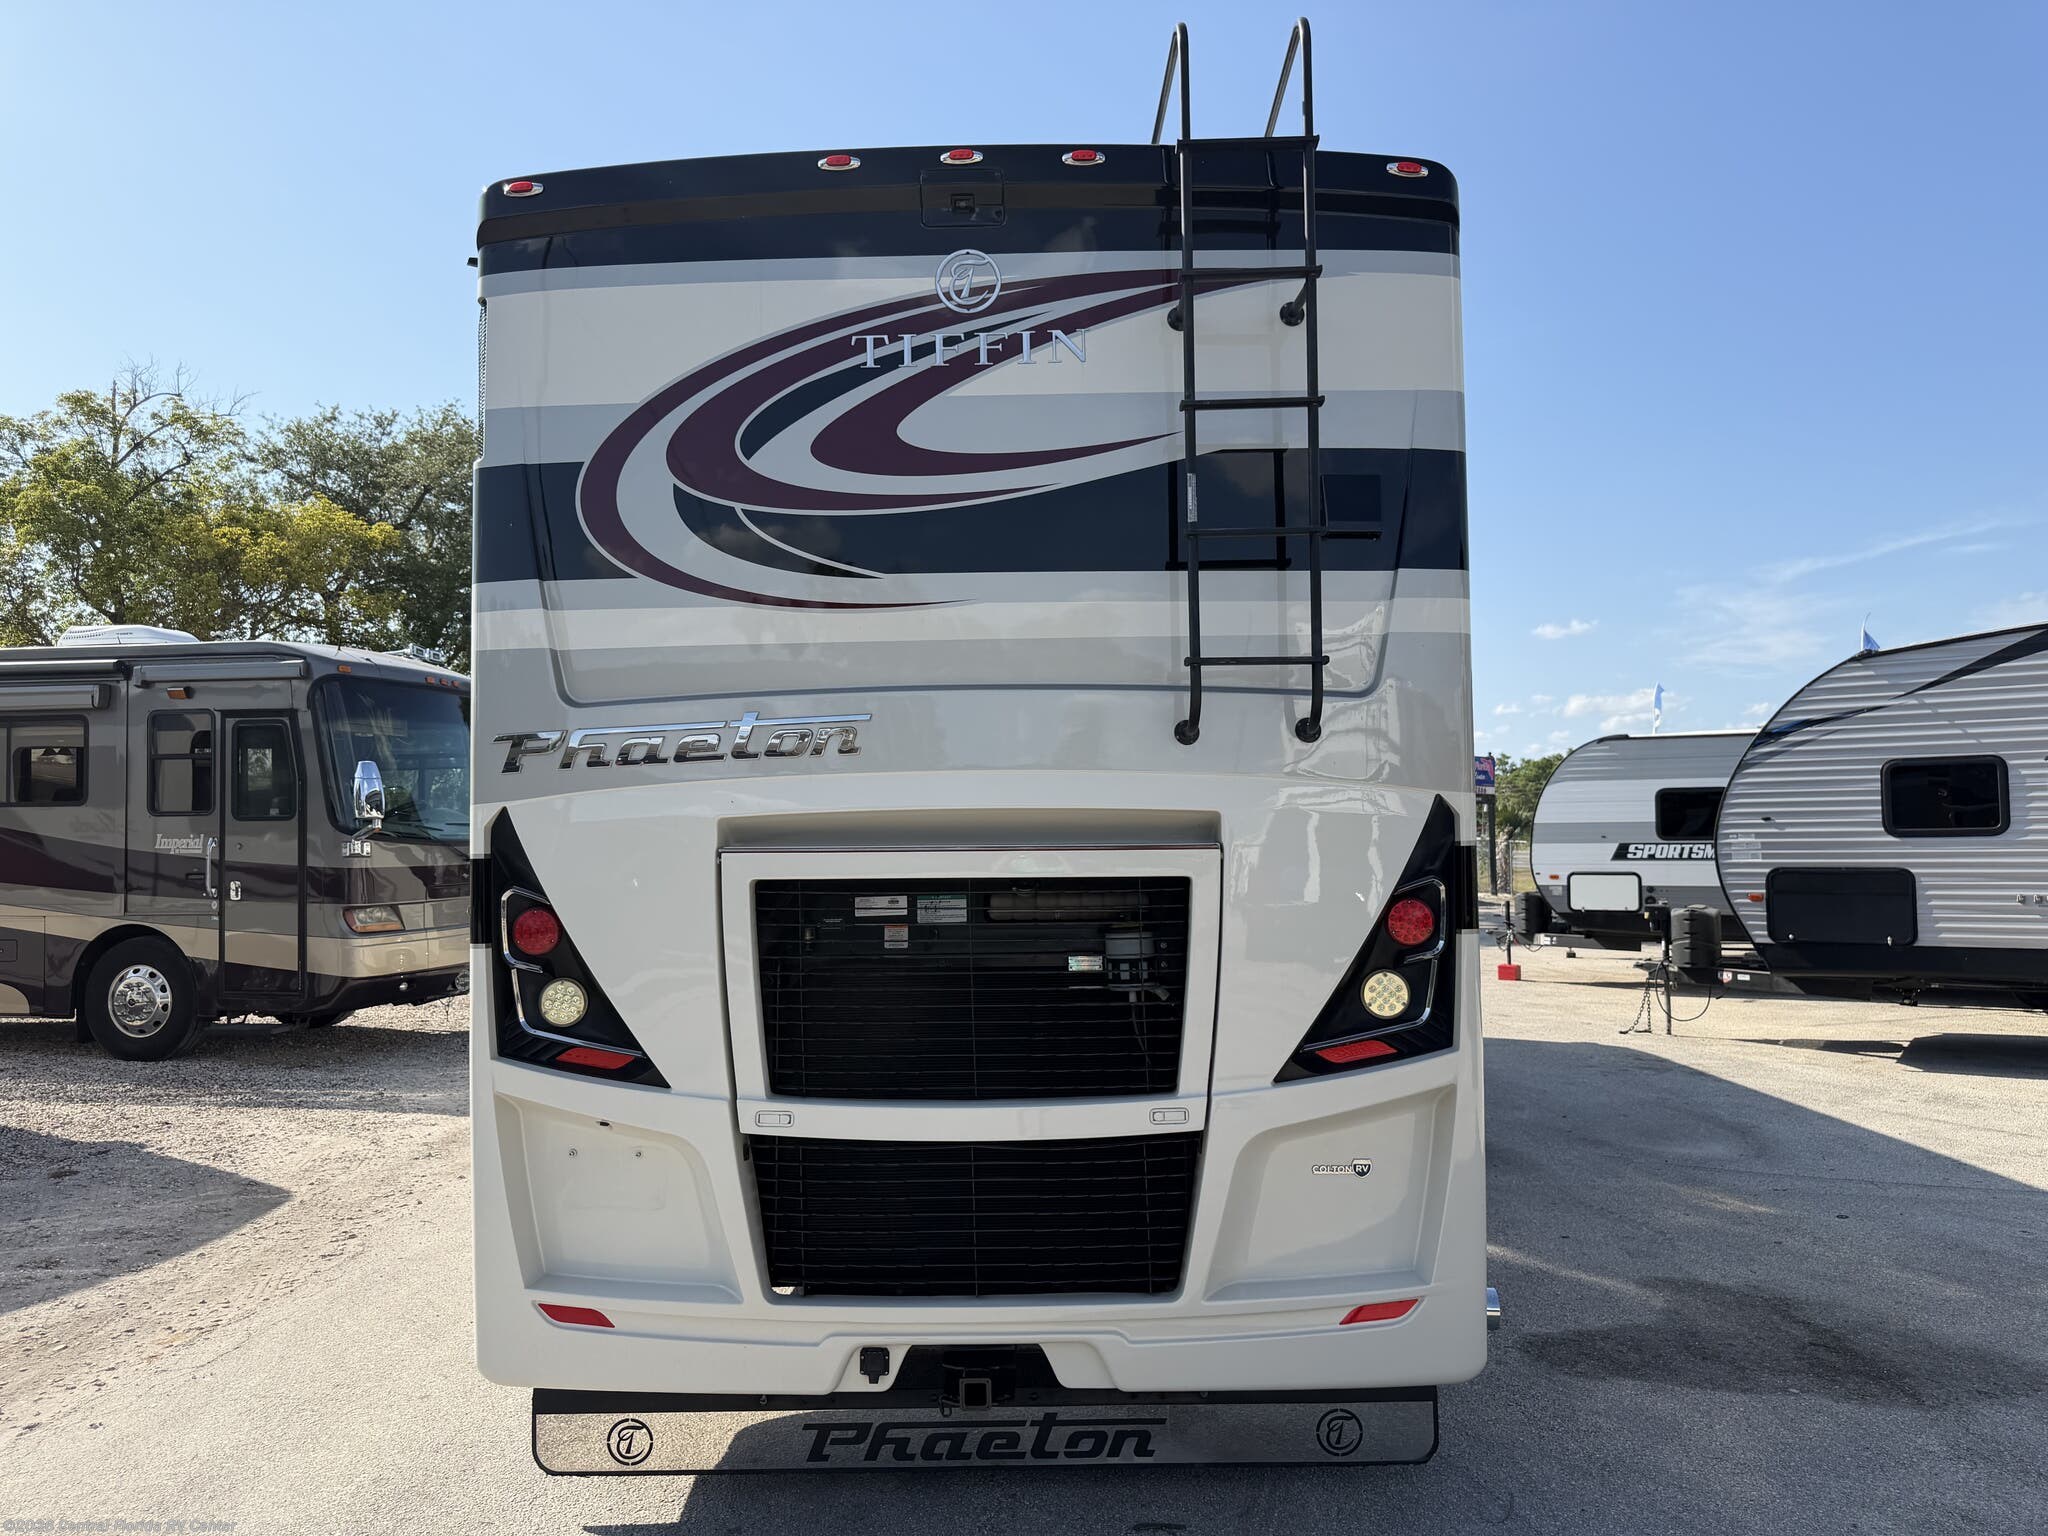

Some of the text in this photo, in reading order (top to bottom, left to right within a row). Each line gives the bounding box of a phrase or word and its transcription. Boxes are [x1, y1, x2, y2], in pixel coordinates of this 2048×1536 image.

[851, 328, 1089, 369] TIFFIN
[493, 711, 873, 775] Phaeton
[154, 833, 205, 855] Imperial
[1311, 1164, 1369, 1175] COLTON RV
[802, 1412, 1167, 1462] Phaeton
